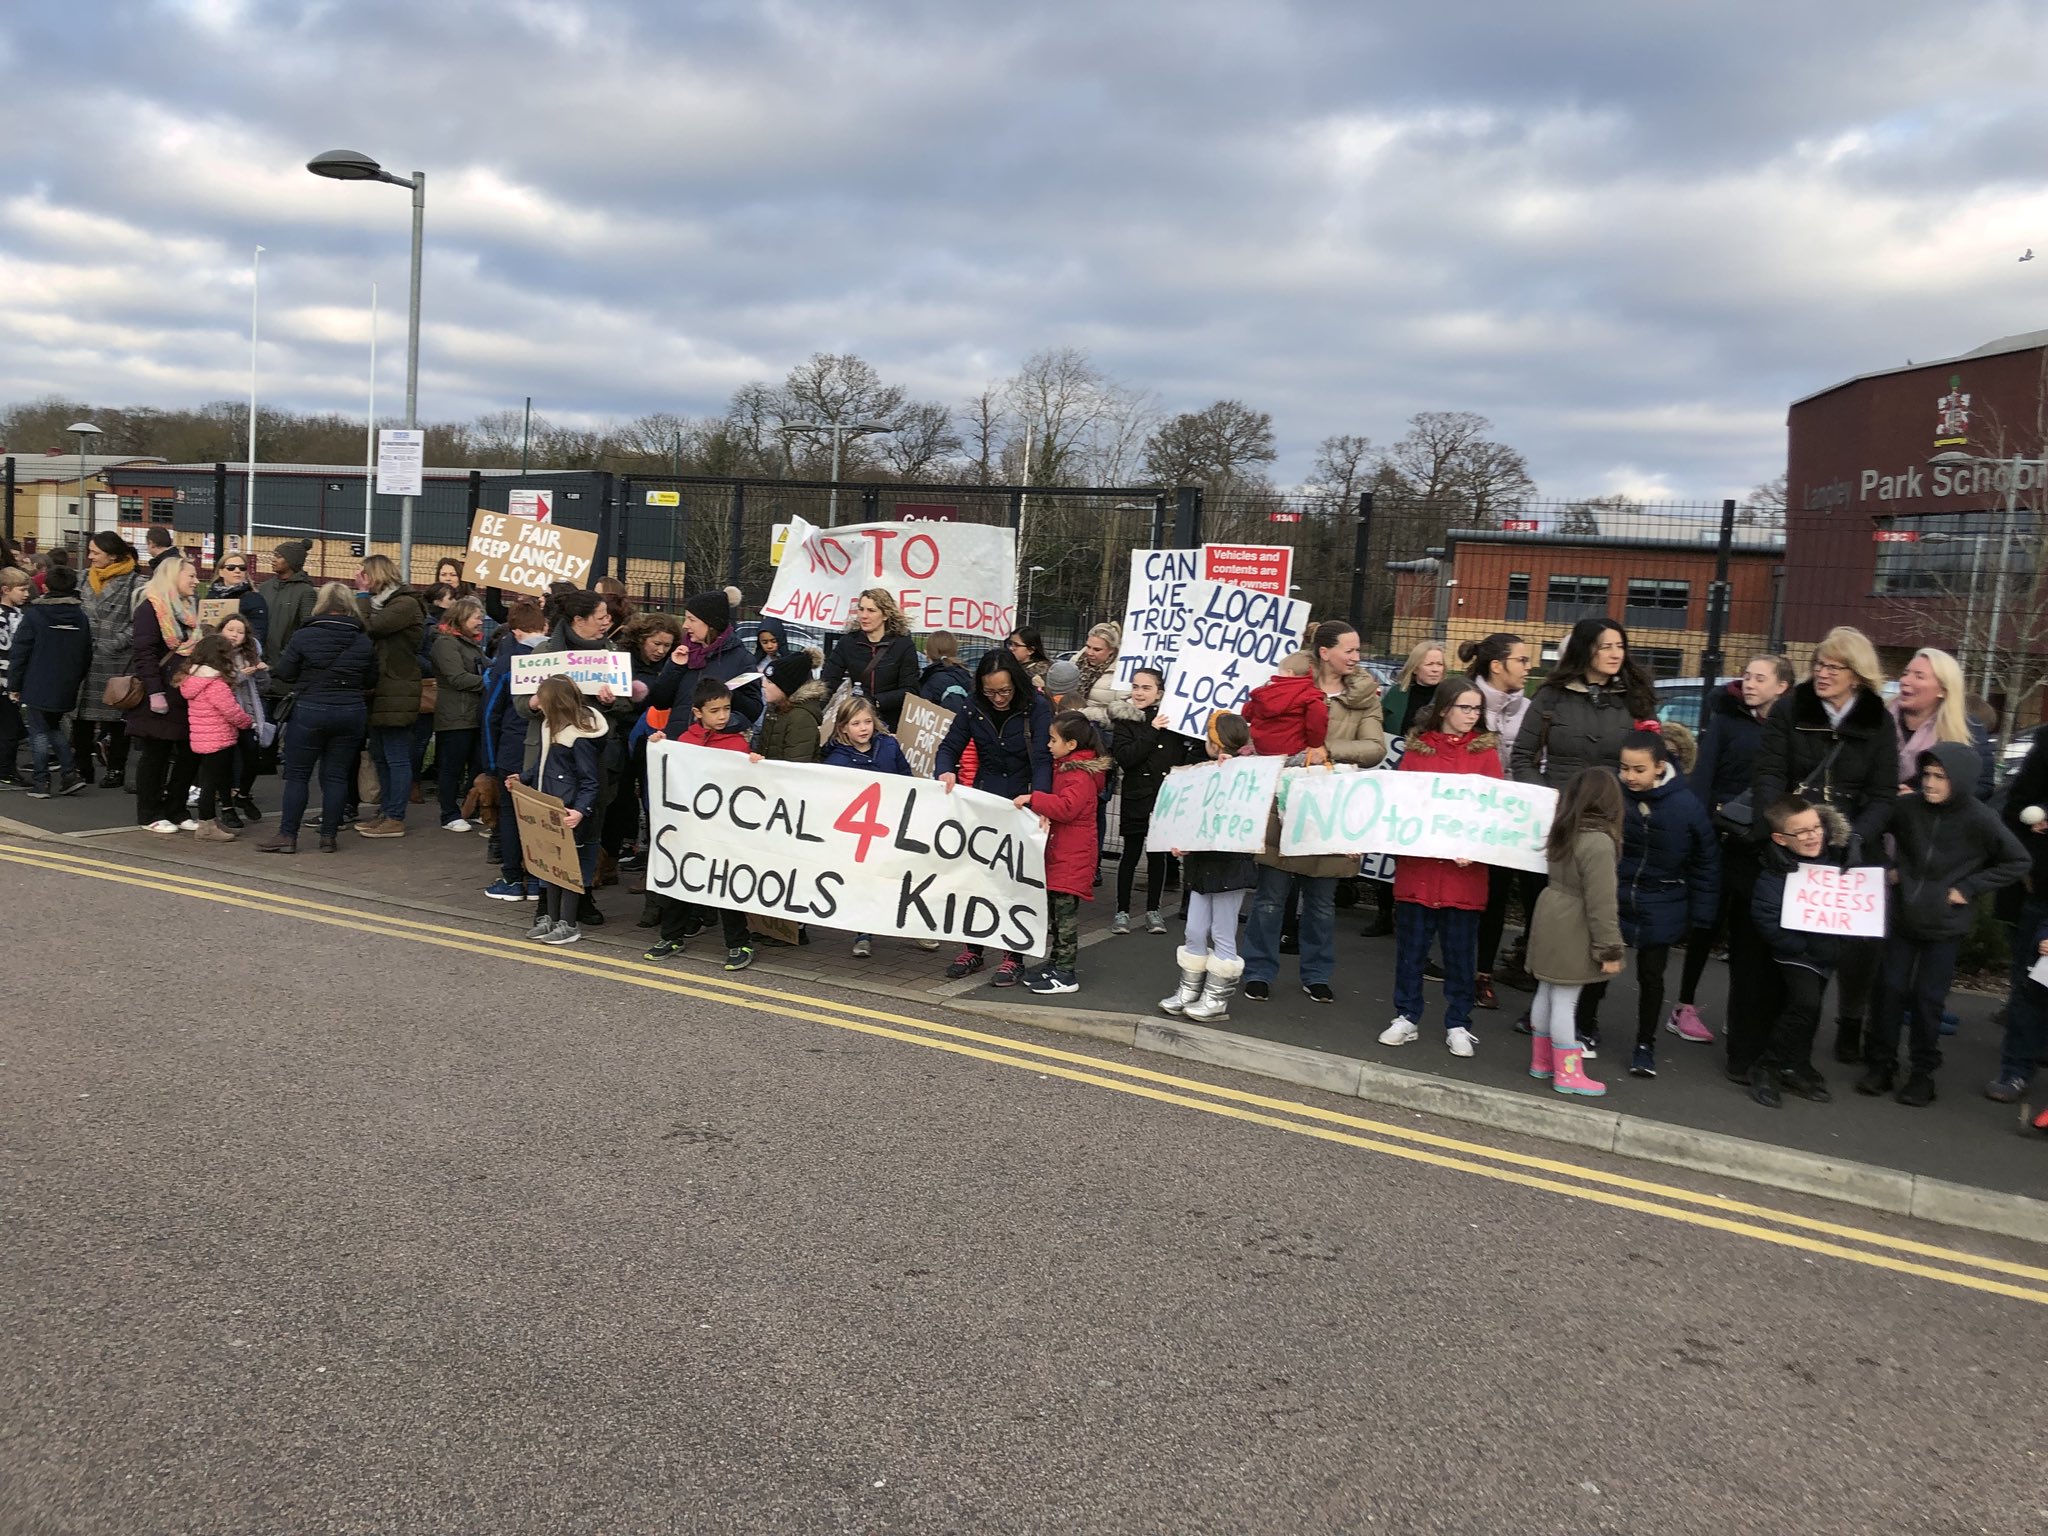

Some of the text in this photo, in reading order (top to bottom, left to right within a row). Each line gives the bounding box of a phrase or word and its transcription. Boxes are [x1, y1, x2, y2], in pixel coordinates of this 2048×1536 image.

[1860, 466, 1924, 500] Park
[480, 514, 562, 550] BE FAIR
[470, 535, 590, 579] KEEP LANGLEY
[802, 530, 940, 580] NO TO
[1145, 552, 1197, 581] CAN
[1212, 565, 1278, 576] contents are
[1213, 549, 1280, 562] Vehicles and
[474, 559, 569, 592] 4 LOCAL
[1240, 581, 1279, 590] owners
[1149, 583, 1187, 607] WE
[1205, 586, 1296, 636] LOCAL
[900, 589, 1014, 637] FEEDERS
[1142, 632, 1182, 652] THE
[1187, 617, 1298, 668] SCHOOLS
[518, 657, 560, 668] LOCAL
[1222, 659, 1239, 681] 4
[1175, 671, 1250, 709] LOCA
[905, 703, 953, 739] LANGLE
[914, 729, 936, 754] FOR
[1156, 782, 1194, 822] WE
[1292, 777, 1384, 845] NO
[1382, 804, 1424, 846] to
[662, 754, 1045, 889] LOCAL 4 LOCAL
[653, 824, 1037, 951] SCHOOLS KIDS
[1807, 868, 1866, 891] KEEP
[1796, 888, 1876, 912] ACCESS
[1803, 908, 1852, 931] FAIR
